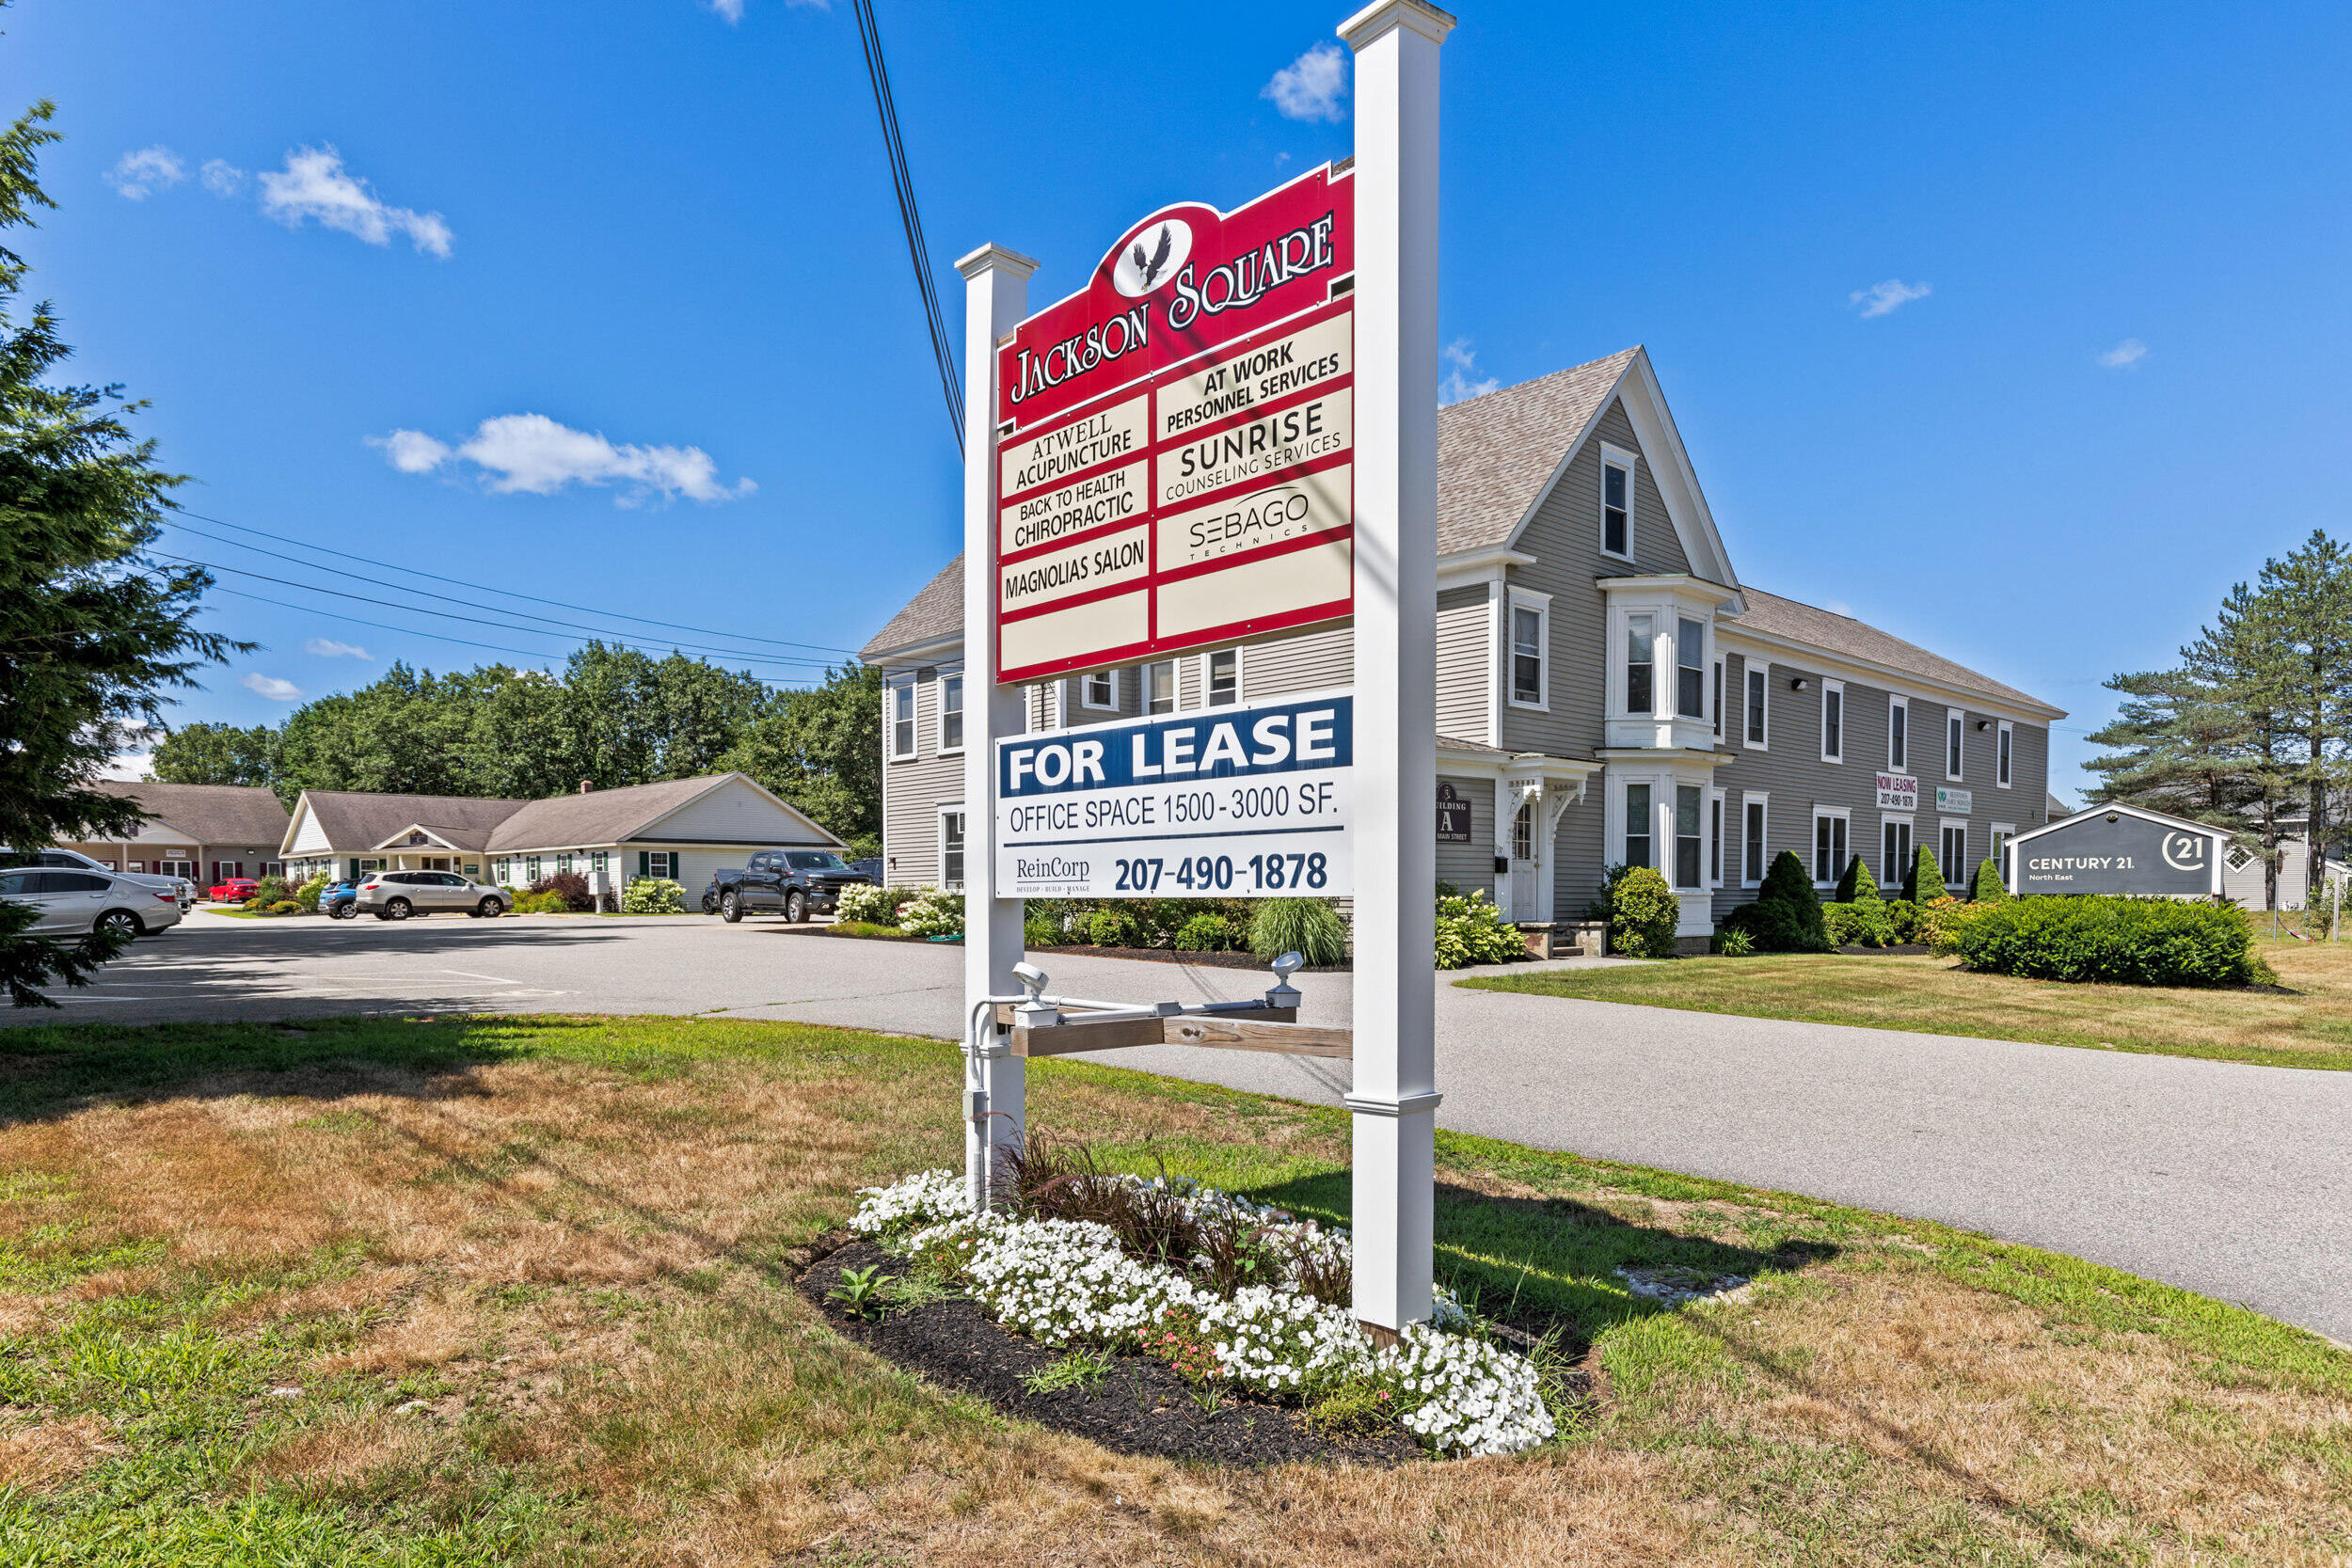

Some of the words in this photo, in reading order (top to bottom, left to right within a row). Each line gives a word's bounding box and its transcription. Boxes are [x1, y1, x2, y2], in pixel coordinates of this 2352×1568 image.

[1010, 300, 1151, 404] JACKSON
[1168, 209, 1335, 331] SQUARE
[1167, 386, 1254, 433] PERSONNEL
[1260, 353, 1339, 400] SERVICES
[1203, 368, 1227, 395] AT
[1232, 341, 1295, 384] WORK
[1016, 429, 1132, 489] ACUPUNCTURE
[1031, 414, 1113, 461] ATWELL
[1181, 402, 1323, 477] SUNRISE
[1166, 458, 1259, 500] COUNSELING
[1264, 432, 1341, 469] SERVICES
[1015, 491, 1134, 547] CHIROPRACTIC
[1020, 496, 1052, 521] BACK
[1056, 489, 1073, 509] TO
[1076, 470, 1125, 502] HEALTH
[1190, 494, 1309, 548] SEBAGO
[1006, 556, 1089, 599] MAGNOLIAS
[1094, 539, 1144, 576] SALON
[1190, 525, 1308, 561] TECHNICS
[1009, 739, 1106, 790] FOR
[1132, 708, 1336, 778] LEASE
[1010, 802, 1079, 832] OFFICE
[1085, 796, 1155, 828] SPACE
[1298, 782, 1338, 816] SF.
[1436, 801, 1467, 811] UILDING
[1878, 775, 1891, 790] NOW
[1893, 777, 1916, 793] LEASING
[1440, 811, 1454, 832] A
[1016, 857, 1089, 881] ReinCorp
[1115, 851, 1327, 891] 207-490-1878
[2029, 858, 2112, 870] CENTURY
